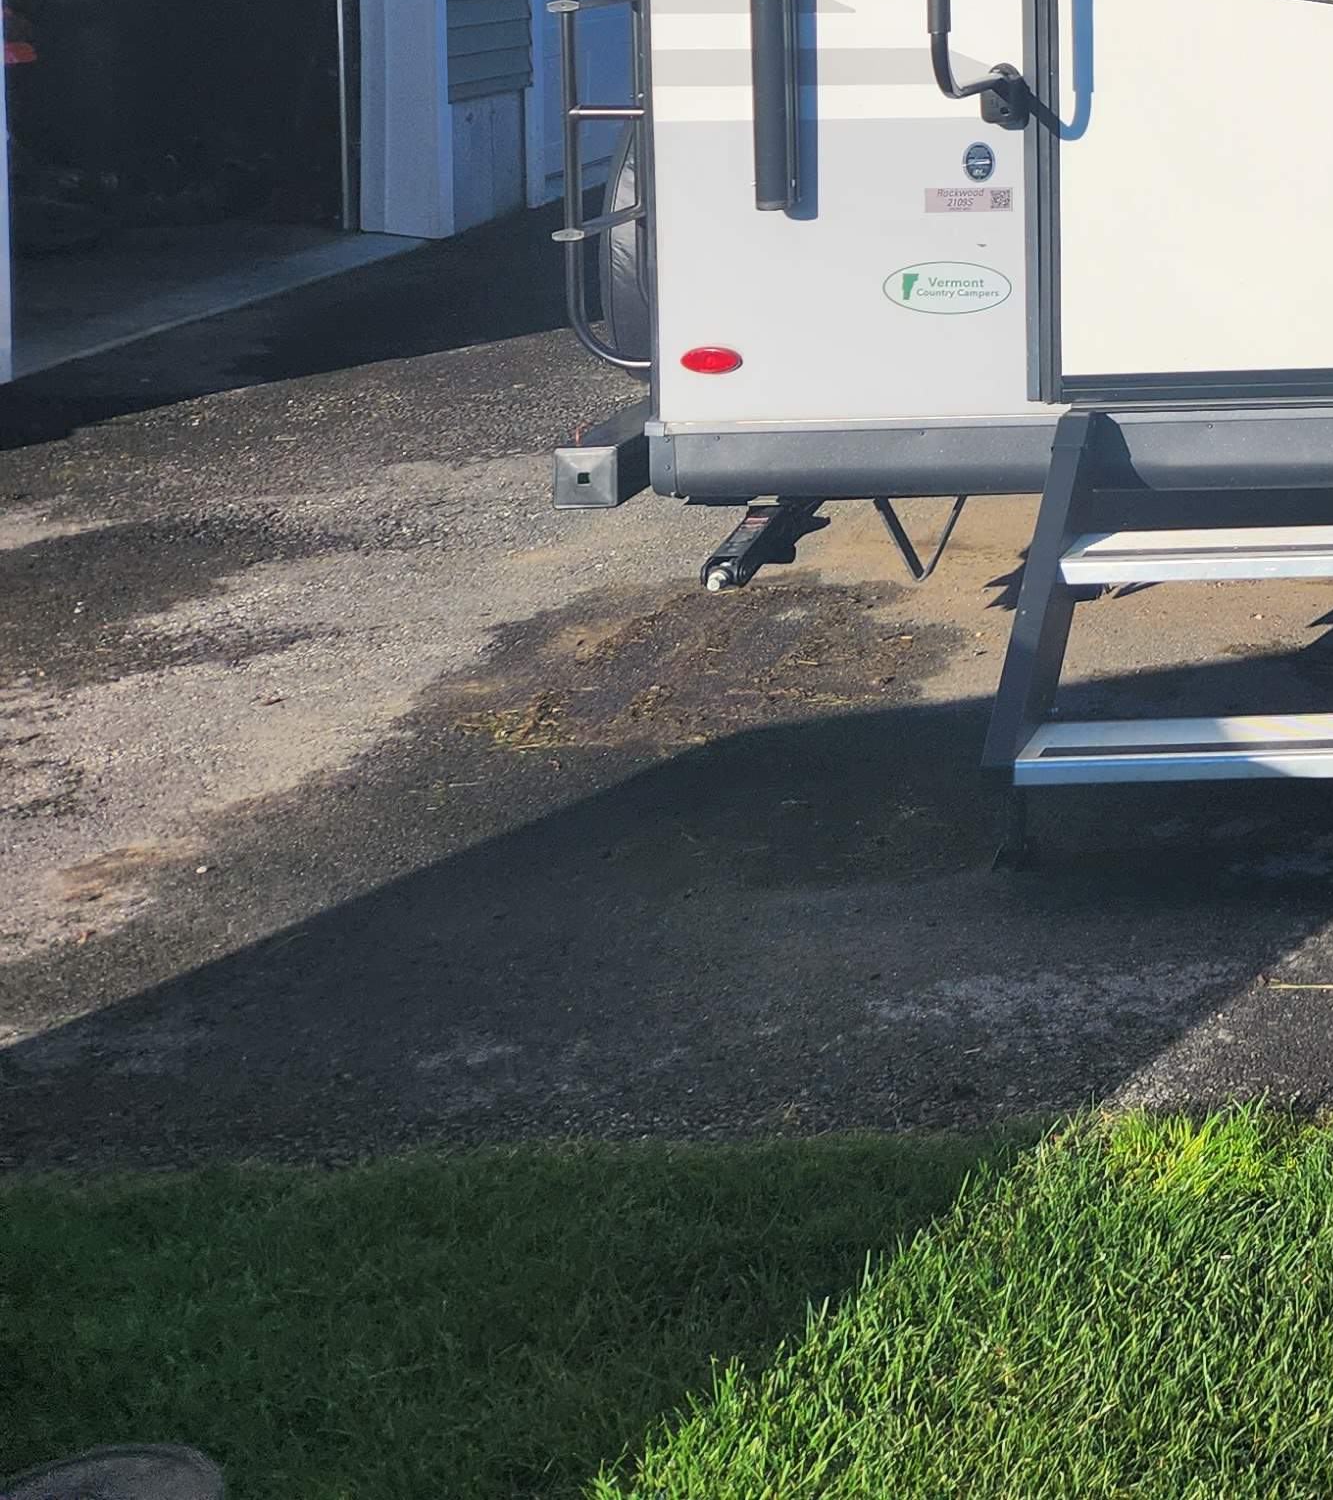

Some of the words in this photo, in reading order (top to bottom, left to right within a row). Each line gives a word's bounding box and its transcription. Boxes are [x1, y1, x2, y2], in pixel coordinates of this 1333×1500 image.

[936, 188, 984, 197] Rockwood
[928, 277, 984, 288] Vermont
[916, 289, 955, 298] Country
[957, 289, 999, 299] Campers
